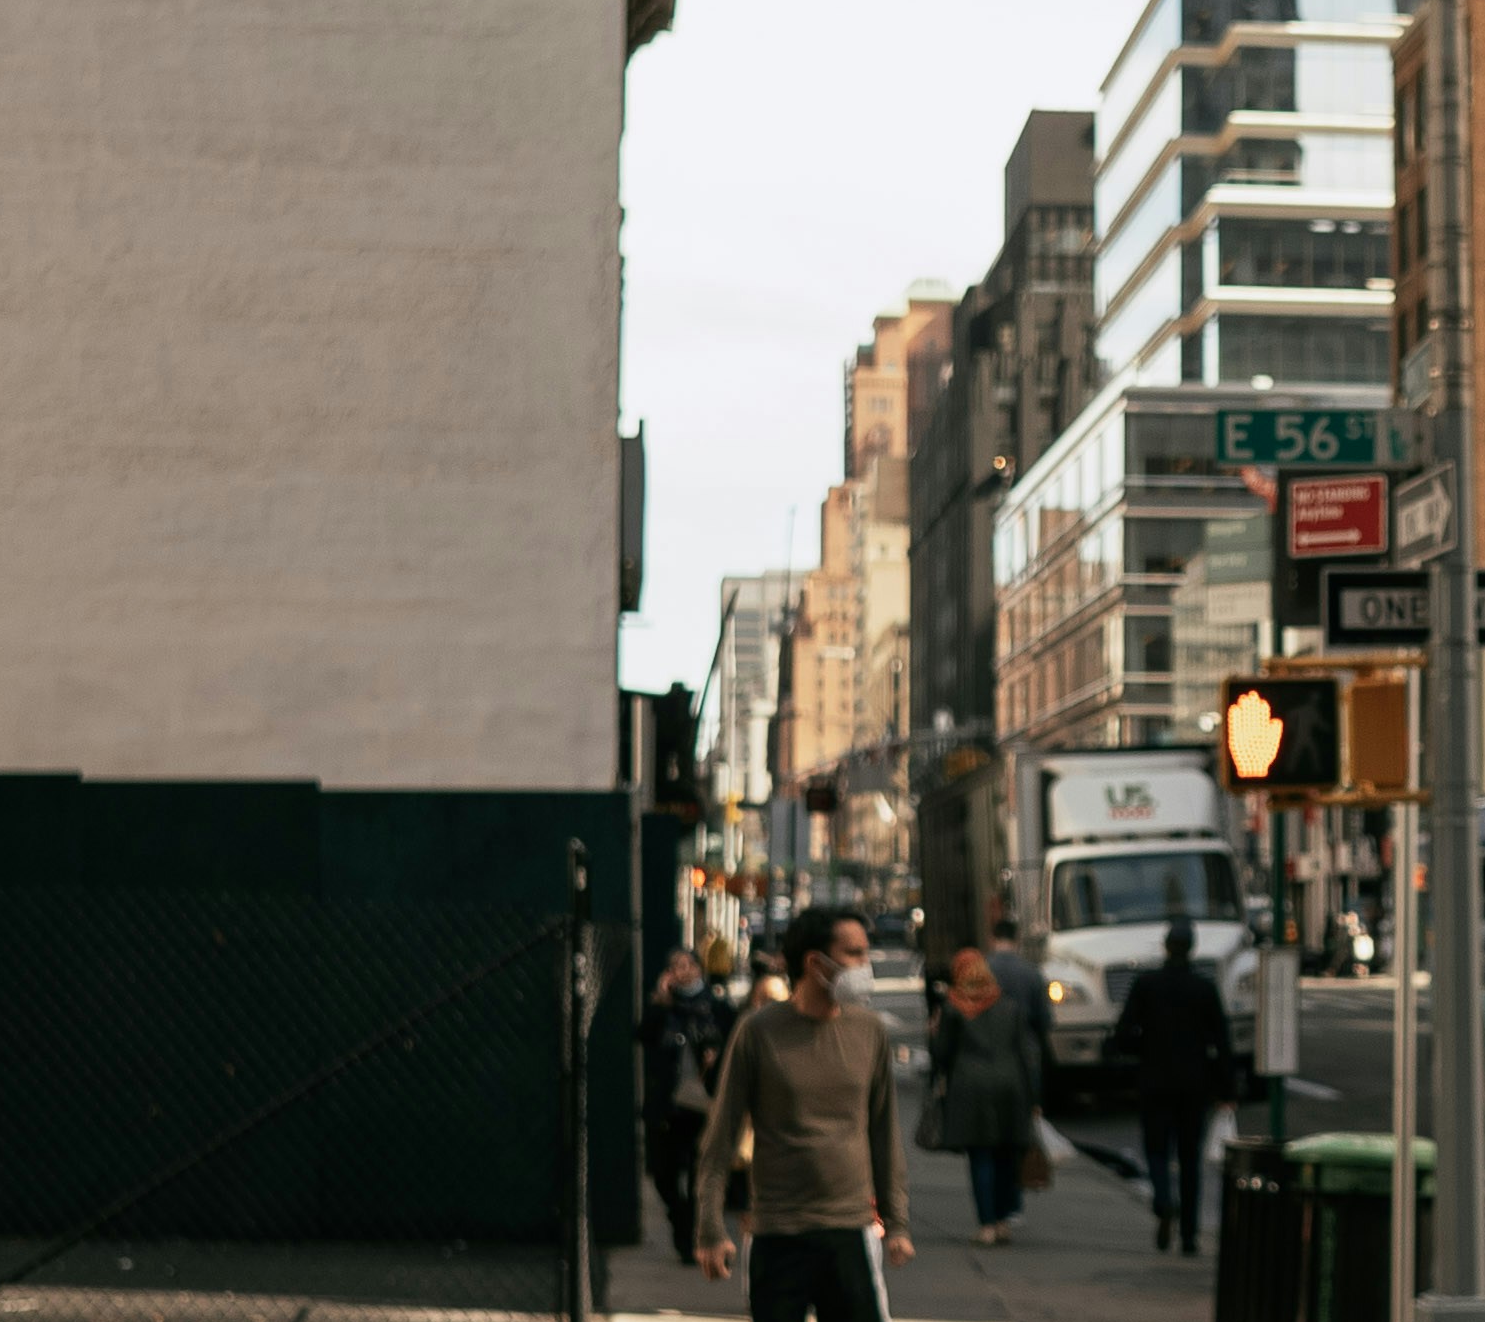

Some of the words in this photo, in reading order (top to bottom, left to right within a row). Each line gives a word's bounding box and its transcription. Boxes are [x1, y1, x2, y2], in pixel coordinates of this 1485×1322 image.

[1225, 414, 1254, 459] E
[1274, 414, 1340, 460] 56
[1359, 596, 1430, 627] ONE
